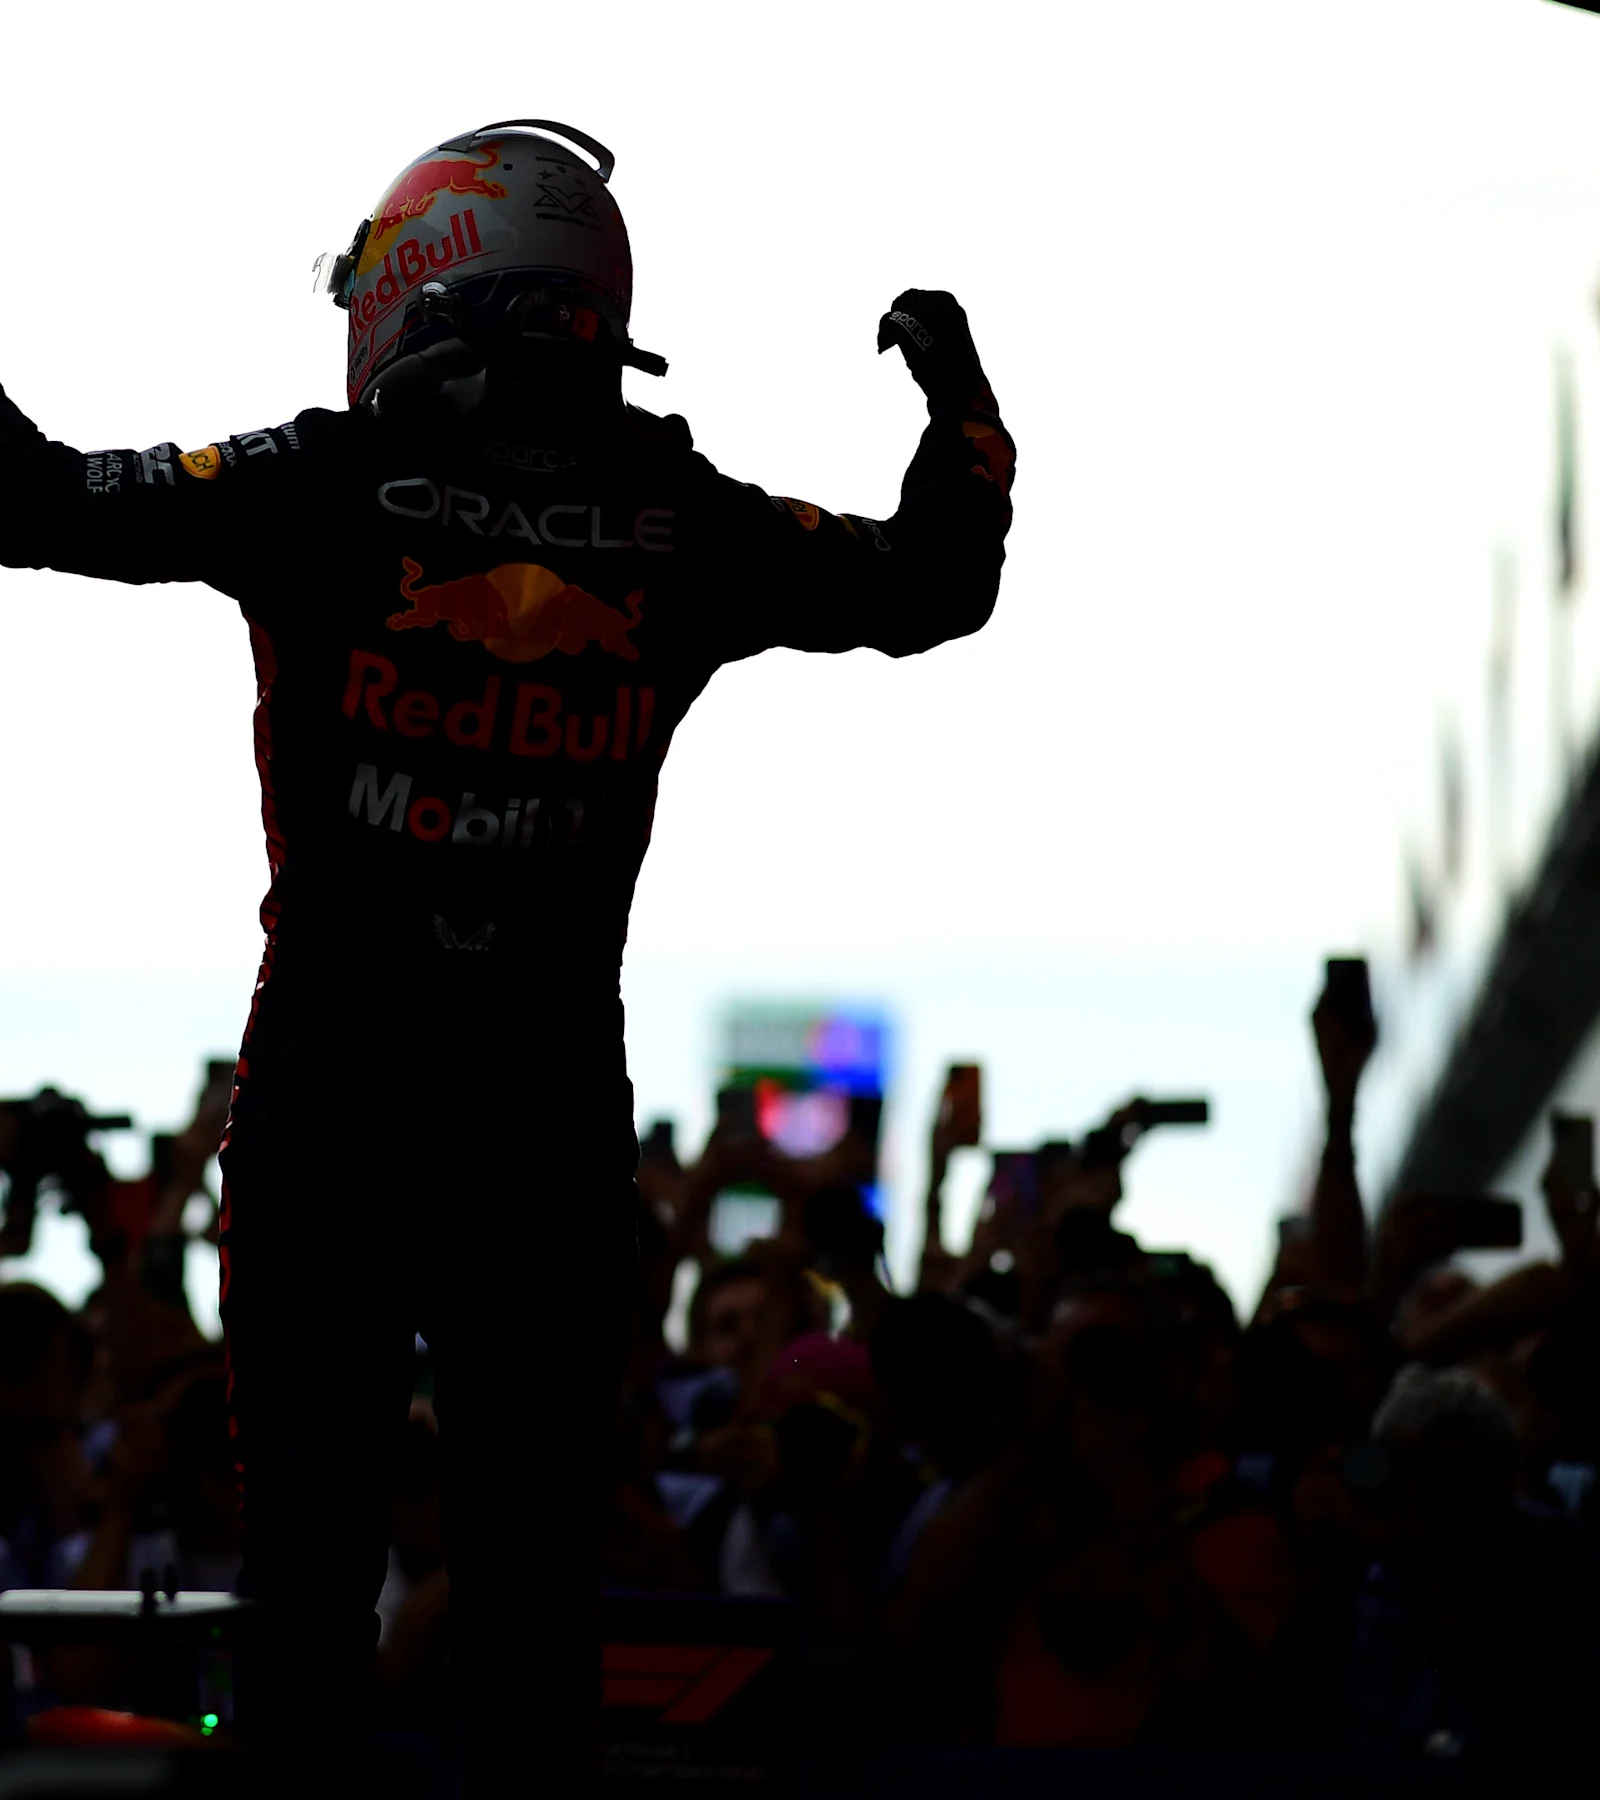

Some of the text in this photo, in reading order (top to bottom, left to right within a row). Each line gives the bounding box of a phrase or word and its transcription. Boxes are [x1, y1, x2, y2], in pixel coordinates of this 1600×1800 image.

[350, 209, 482, 338] Red Bull
[889, 310, 935, 352] sparco
[85, 456, 104, 495] WOLF
[377, 477, 676, 553] ORACLE
[340, 646, 658, 763] Red Bull
[347, 762, 540, 850] Mobil
